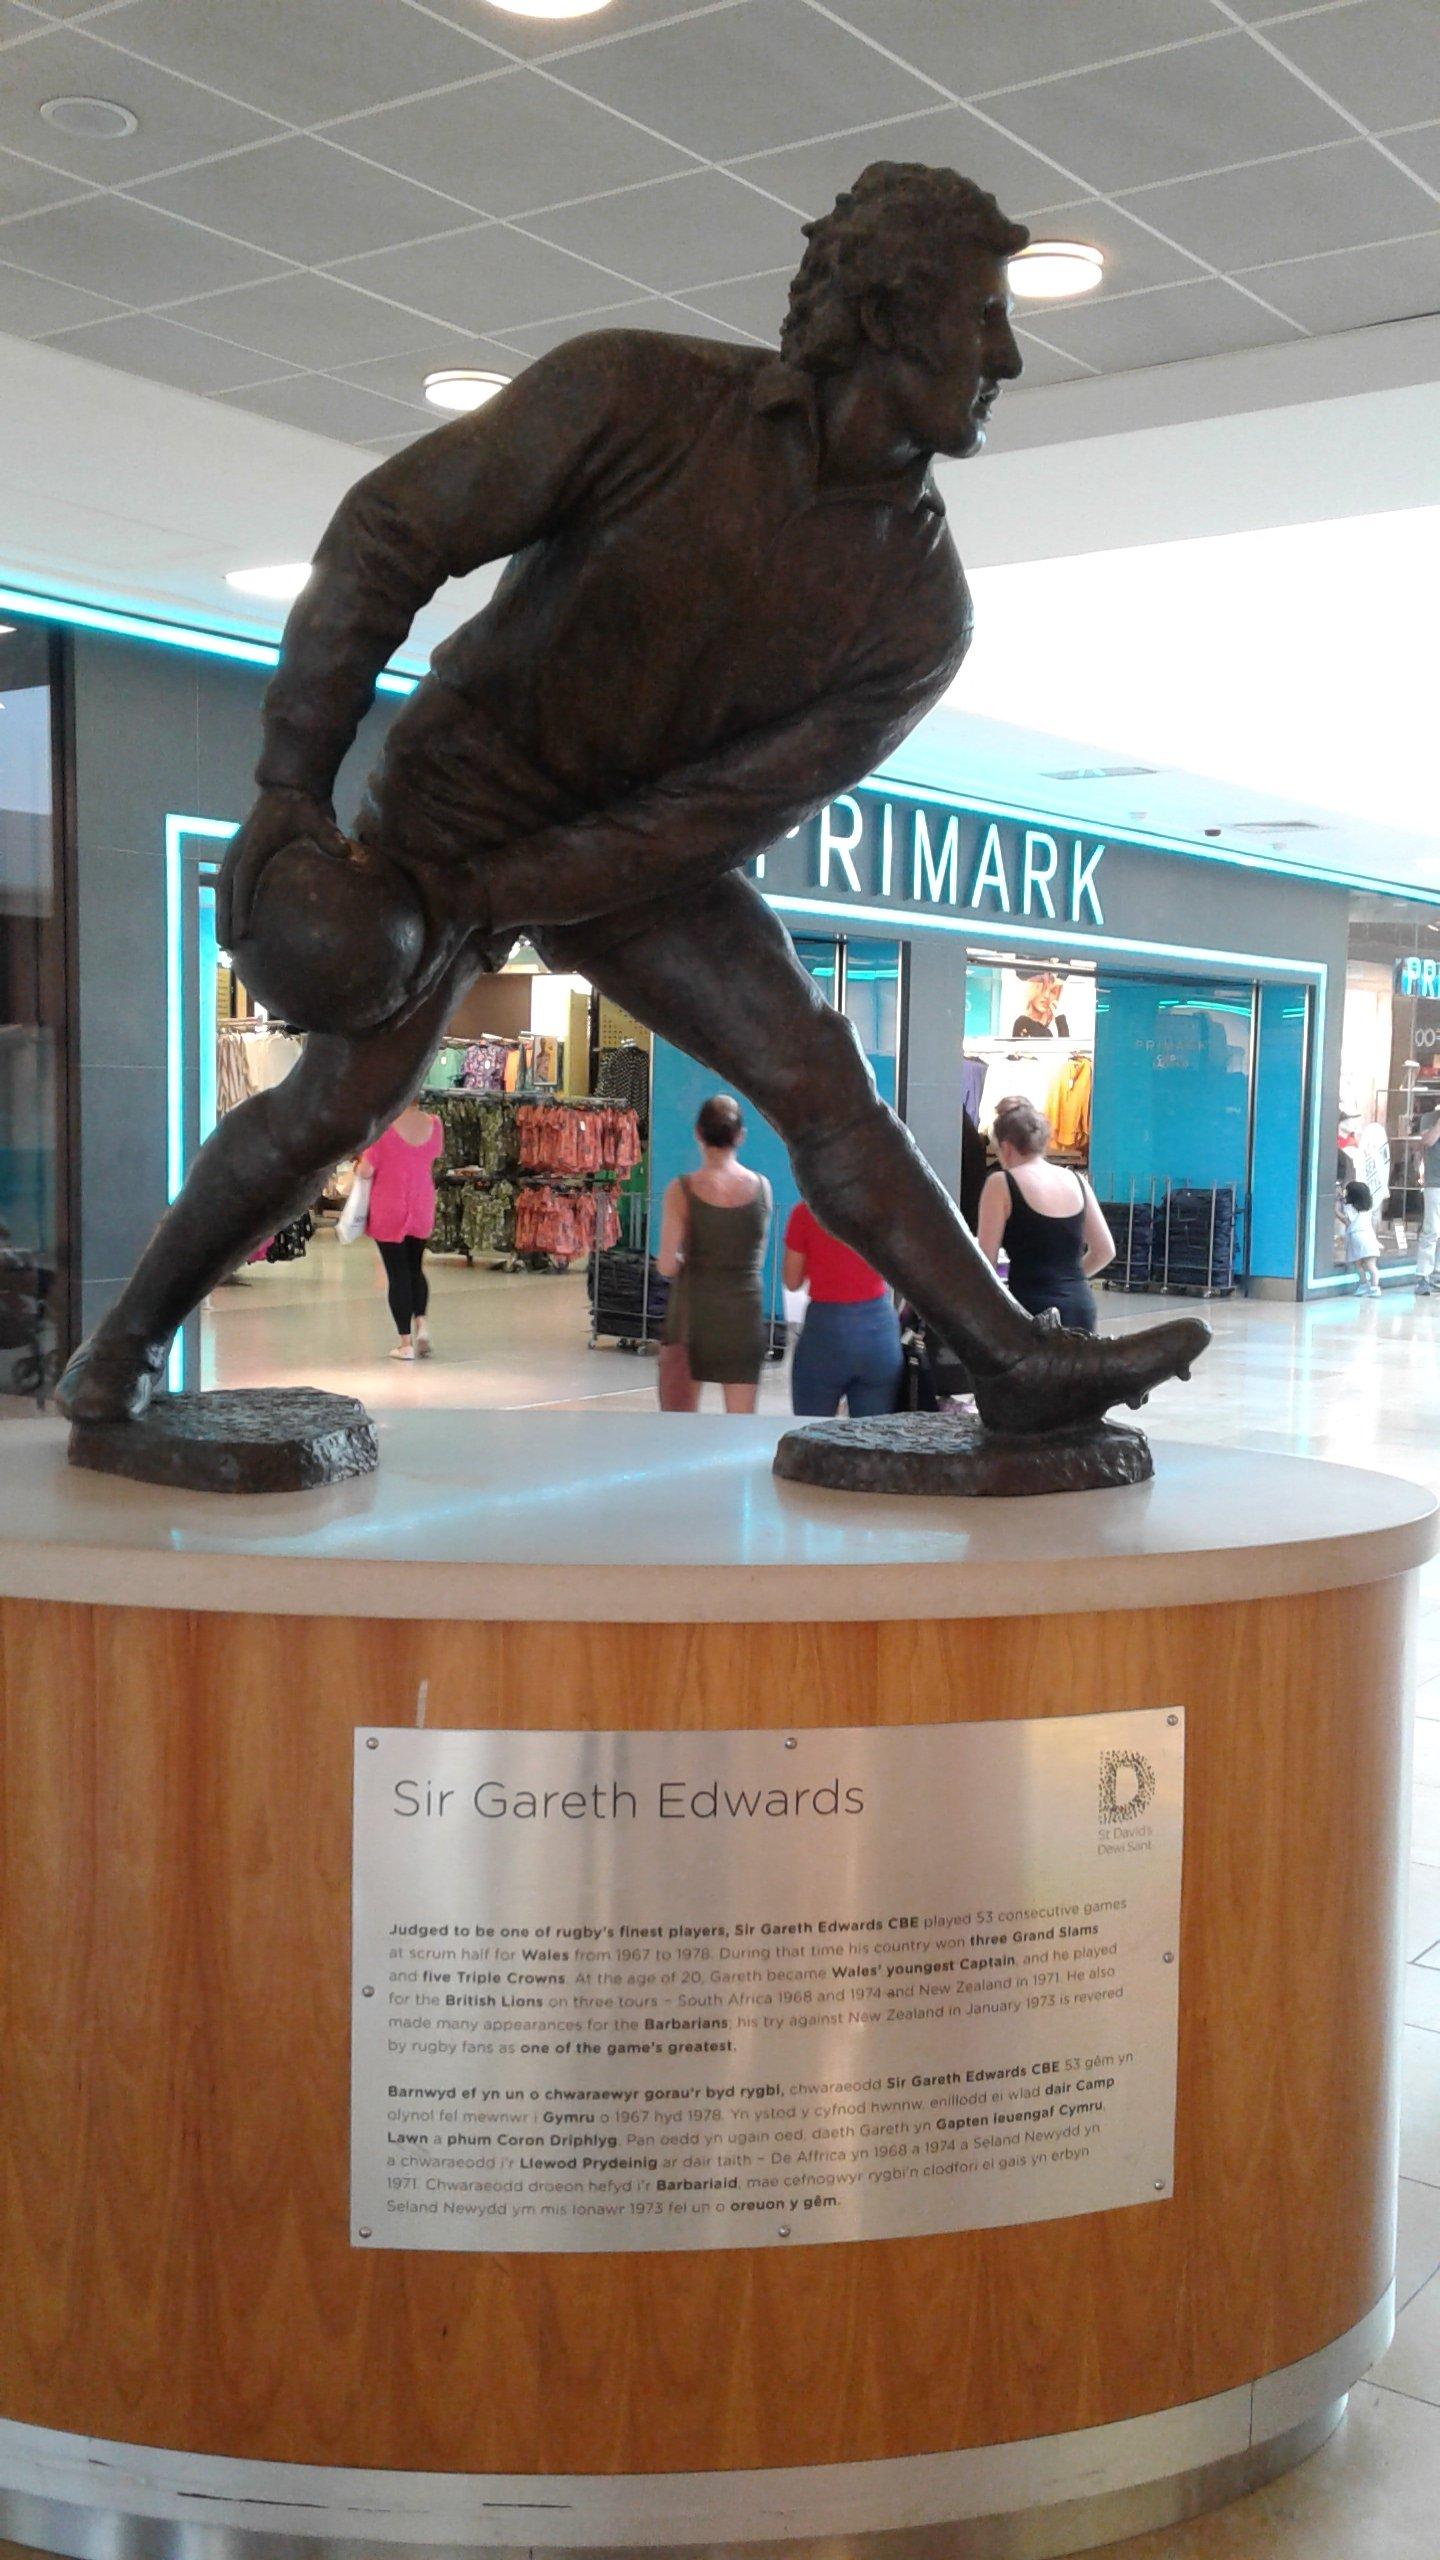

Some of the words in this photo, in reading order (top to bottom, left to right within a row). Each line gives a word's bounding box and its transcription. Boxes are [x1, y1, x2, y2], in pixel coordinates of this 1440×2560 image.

[756, 794, 1106, 926] RIMARK
[394, 1780, 454, 1817] Sir
[474, 1781, 637, 1819] Gareth
[659, 1778, 865, 1818] Edwards
[1127, 1841, 1152, 1853] Sant
[389, 1924, 448, 1938] Judged
[454, 1926, 469, 1937] to
[476, 1925, 494, 1937] be
[501, 1927, 529, 1937] one
[535, 1925, 551, 1937] of
[556, 1926, 614, 1939] rugby's
[620, 1925, 663, 1938] finest
[735, 1925, 755, 1936] Sir
[761, 1923, 812, 1935] Gareth
[818, 1919, 882, 1933] Edwards
[888, 1917, 918, 1929] CBE
[924, 1914, 971, 1929] played
[998, 1904, 1079, 1922] consecutive
[1084, 1899, 1126, 1915] games
[410, 1951, 455, 1959] scrum
[461, 1949, 488, 1960] half
[495, 1949, 515, 1960] for
[522, 1949, 569, 1961] Wales
[575, 1950, 610, 1960] from
[618, 1950, 649, 1961] 1967
[719, 1947, 770, 1960] During
[776, 1946, 805, 1958] that
[811, 1944, 844, 1956] time
[875, 1940, 930, 1954] country
[970, 1934, 1007, 1947] three
[1013, 1930, 1054, 1943] Grand
[1059, 1924, 1098, 1938] Slams
[423, 1971, 450, 1982] five
[458, 1971, 501, 1985] Triple
[598, 1973, 622, 1985] the
[710, 1969, 761, 1982] Gareth
[768, 1968, 826, 1981] became
[832, 1965, 882, 1978] Wales'
[887, 1962, 954, 1978] youngest
[1073, 1943, 1117, 1960] played
[416, 1993, 440, 2005] the
[446, 1994, 496, 2007] British
[502, 1995, 542, 2007] Lions
[573, 1996, 613, 2008] three
[619, 1995, 657, 2008] tours
[678, 1994, 723, 2006] South
[729, 1992, 772, 2005] Africa
[780, 1990, 812, 2004] 1968
[817, 1990, 845, 2001] and
[851, 1988, 881, 1999] 1974
[887, 1985, 913, 1998] and
[956, 1978, 1011, 1993] Zealand
[1089, 1966, 1115, 1978] also
[389, 2017, 431, 2029] made
[437, 2019, 478, 2031] many
[484, 2020, 582, 2031] appearances
[587, 2019, 608, 2030] for
[764, 2017, 784, 2029] try
[789, 2013, 842, 2026] against
[849, 2011, 880, 2023] New
[887, 2006, 944, 2021] Zealand
[967, 2001, 1021, 2015] January
[1027, 1995, 1055, 2009] 1973
[1074, 1988, 1123, 2003] revered
[412, 2041, 456, 2055] rugby
[462, 2041, 493, 2053] fans
[521, 2044, 549, 2054] one
[555, 2043, 570, 2054] of
[576, 2042, 601, 2054] the
[607, 2043, 662, 2055] game's
[388, 2086, 455, 2100] Barnwyd
[462, 2088, 476, 2099] ef
[482, 2090, 500, 2101] yn
[506, 2090, 524, 2099] un
[530, 2090, 539, 2100] o
[546, 2088, 639, 2102] chwaraewyr
[645, 2088, 700, 2100] gorau'r
[707, 2086, 734, 2099] byd
[790, 2079, 881, 2095] chwaraeodd
[887, 2077, 905, 2089] Sir
[912, 2073, 961, 2086] Gareth
[966, 2067, 1026, 2082] Edwards
[1032, 2062, 1059, 2075] CBE
[1085, 2055, 1114, 2069] gêm
[387, 2109, 433, 2123] olynol
[464, 2113, 528, 2122] mewnwr
[544, 2112, 594, 2125] Gymru
[615, 2111, 648, 2123] 1967
[755, 2107, 796, 2121] ystod
[815, 2103, 866, 2117] cyfnod
[930, 2092, 986, 2108] enillodd
[1009, 2087, 1040, 2100] wlad
[1045, 2083, 1071, 2096] dair
[1077, 2077, 1115, 2092] Camp
[387, 2132, 428, 2144] Lawn
[448, 2134, 491, 2147] phum
[497, 2134, 544, 2146] Coron
[661, 2134, 699, 2145] oedd
[728, 2132, 769, 2145] ugain
[812, 2128, 854, 2140] daeth
[860, 2123, 909, 2135] Gareth
[936, 2116, 988, 2132] Gapten
[401, 2156, 495, 2169] chwaraeodd
[521, 2158, 576, 2169] Llewod
[583, 2158, 657, 2171] Prydeinig
[683, 2156, 711, 2167] dair
[718, 2154, 750, 2166] taith
[797, 2149, 846, 2164] Affrica
[874, 2144, 906, 2157] 1968
[925, 2139, 955, 2153] 1974
[974, 2133, 1020, 2149] Seland
[1025, 2125, 1080, 2142] Newydd
[426, 2178, 523, 2192] Chwaraeodd
[528, 2180, 583, 2192] droeon
[589, 2179, 631, 2192] hefyd
[784, 2170, 864, 2187] cefnogwyr
[869, 2165, 918, 2183] rygbi'n
[924, 2159, 978, 2177] clodfori
[999, 2156, 1026, 2170] gais
[1052, 2146, 1089, 2162] erbyn
[387, 2200, 437, 2213] Seland
[444, 2201, 507, 2216] Newydd
[573, 2204, 625, 2216] Ionawr
[630, 2202, 663, 2215] 1973
[731, 2199, 785, 2212] oreuon
[790, 2199, 798, 2210] y
